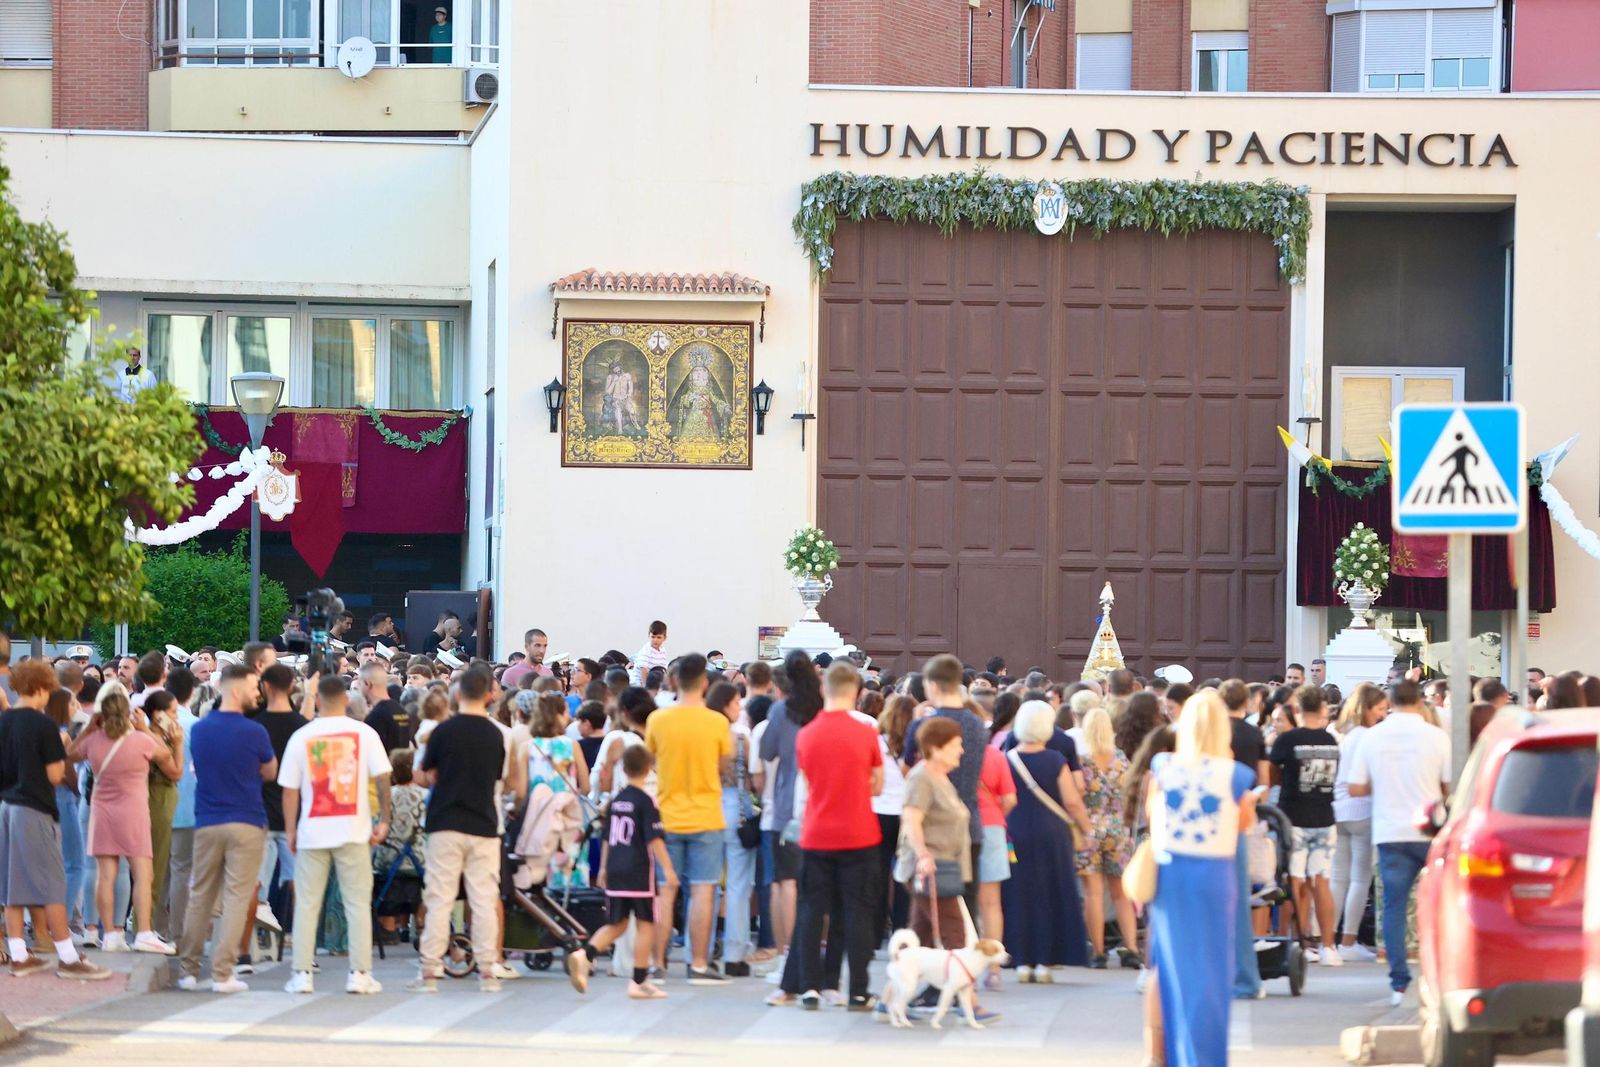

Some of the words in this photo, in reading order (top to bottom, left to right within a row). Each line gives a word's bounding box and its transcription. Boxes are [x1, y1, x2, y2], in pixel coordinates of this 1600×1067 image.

[809, 122, 1137, 164] HUMILDAD
[1151, 129, 1190, 164] Y
[1205, 130, 1519, 169] PACIENCIA
[609, 815, 635, 846] 10
